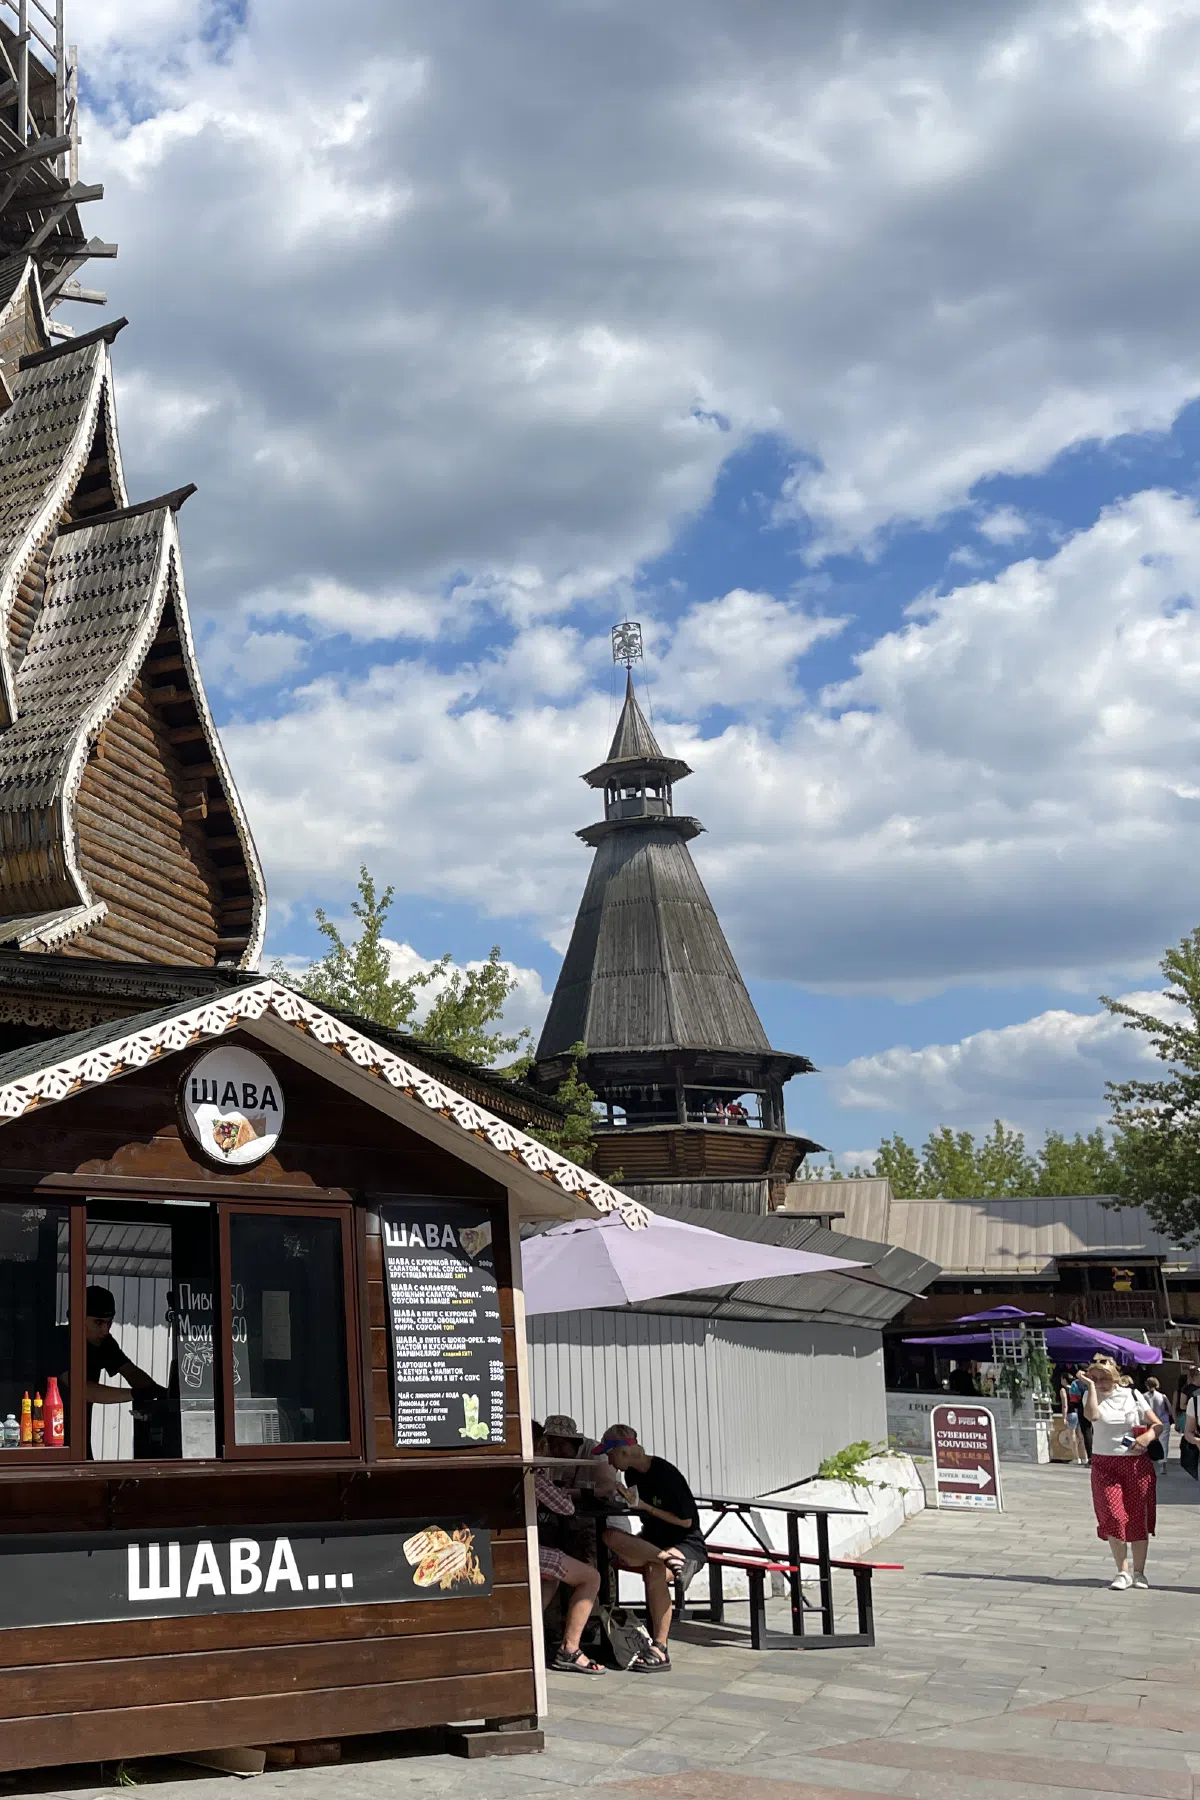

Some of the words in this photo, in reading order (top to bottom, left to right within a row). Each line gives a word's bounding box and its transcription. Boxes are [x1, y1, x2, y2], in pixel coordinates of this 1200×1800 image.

[191, 1078, 279, 1112] ШАВА
[384, 1221, 458, 1248] ШАВА
[388, 1257, 411, 1266] ШАВА
[390, 1283, 413, 1291] ШАВА
[393, 1309, 416, 1317] ШАВА
[178, 1313, 214, 1342] Мохи
[395, 1336, 418, 1344] ШАВА
[936, 1430, 988, 1440] СУВЕНИРЫ
[937, 1439, 988, 1450] SOUVENIRS
[127, 1536, 354, 1602] ШАВА...
